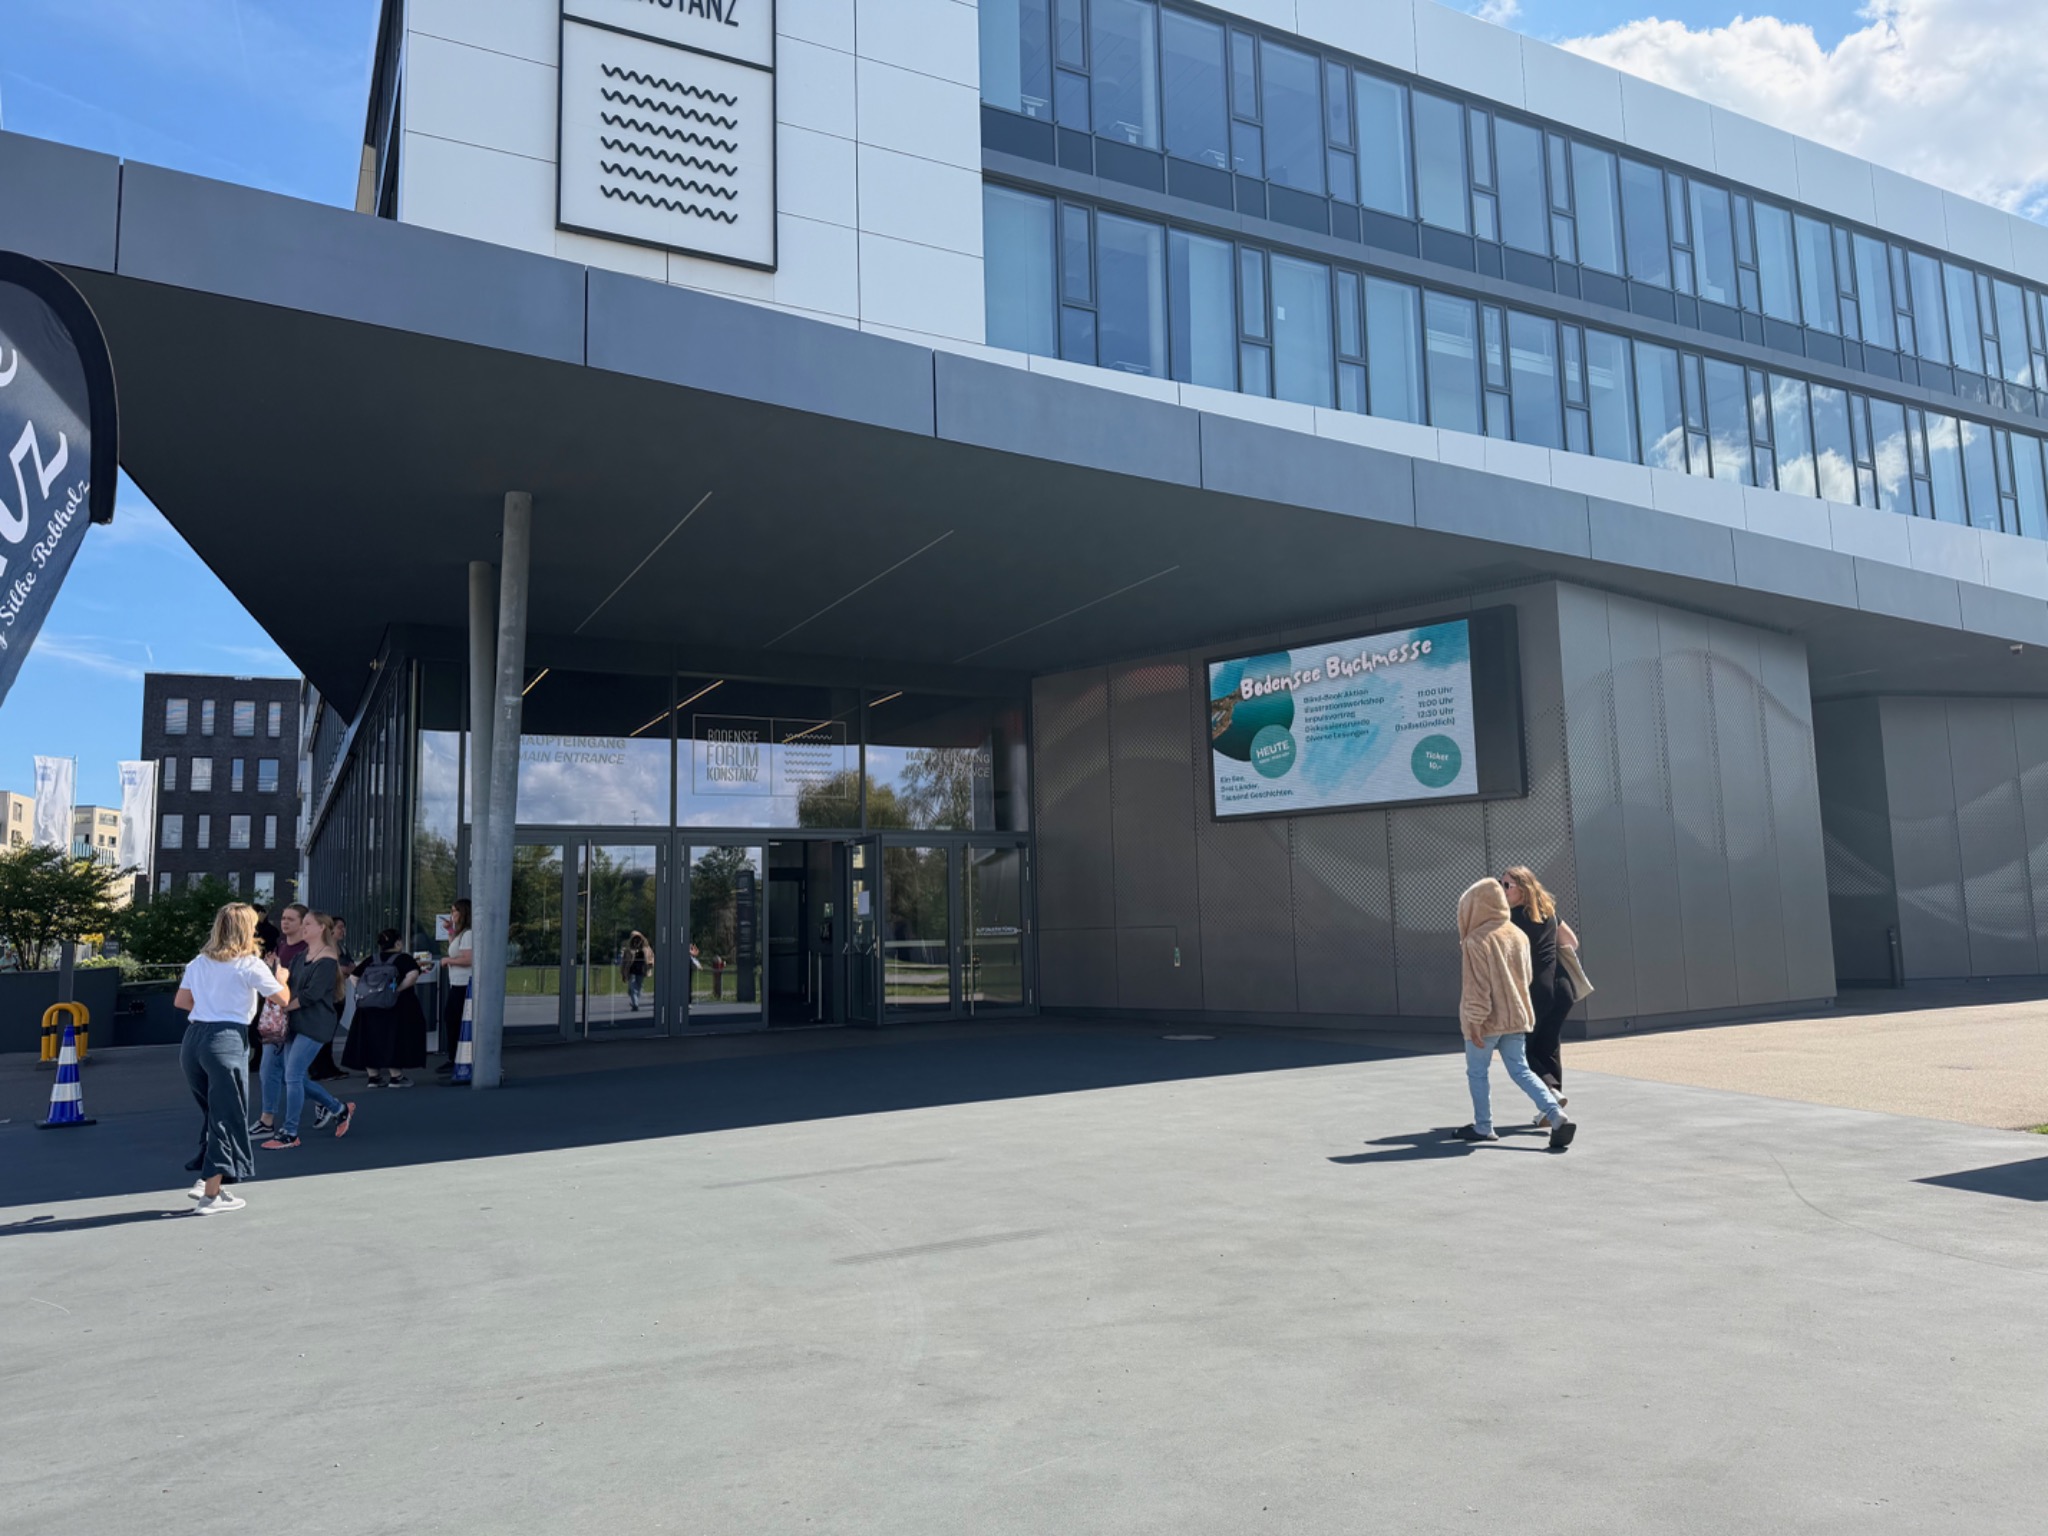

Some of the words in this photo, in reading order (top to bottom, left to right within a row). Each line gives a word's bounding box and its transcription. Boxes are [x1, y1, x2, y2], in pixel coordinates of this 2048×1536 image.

[0, 571, 37, 626] Silke
[32, 479, 91, 569] Rebholz
[1240, 668, 1321, 700] Bodensee
[1326, 639, 1432, 678] Buchmesse
[1417, 687, 1436, 697] 11:00
[1438, 686, 1453, 695] Uhr
[1418, 699, 1438, 708] 11:00
[1439, 697, 1454, 706] Uhr
[1439, 707, 1454, 716] Uhr
[707, 728, 759, 745] BODENSEE
[707, 744, 759, 768] FORUM
[1256, 740, 1290, 759] HEUTE
[1425, 751, 1449, 761] Ticket
[554, 751, 626, 765] ENTRANCE
[707, 767, 759, 782] KONSTANZ
